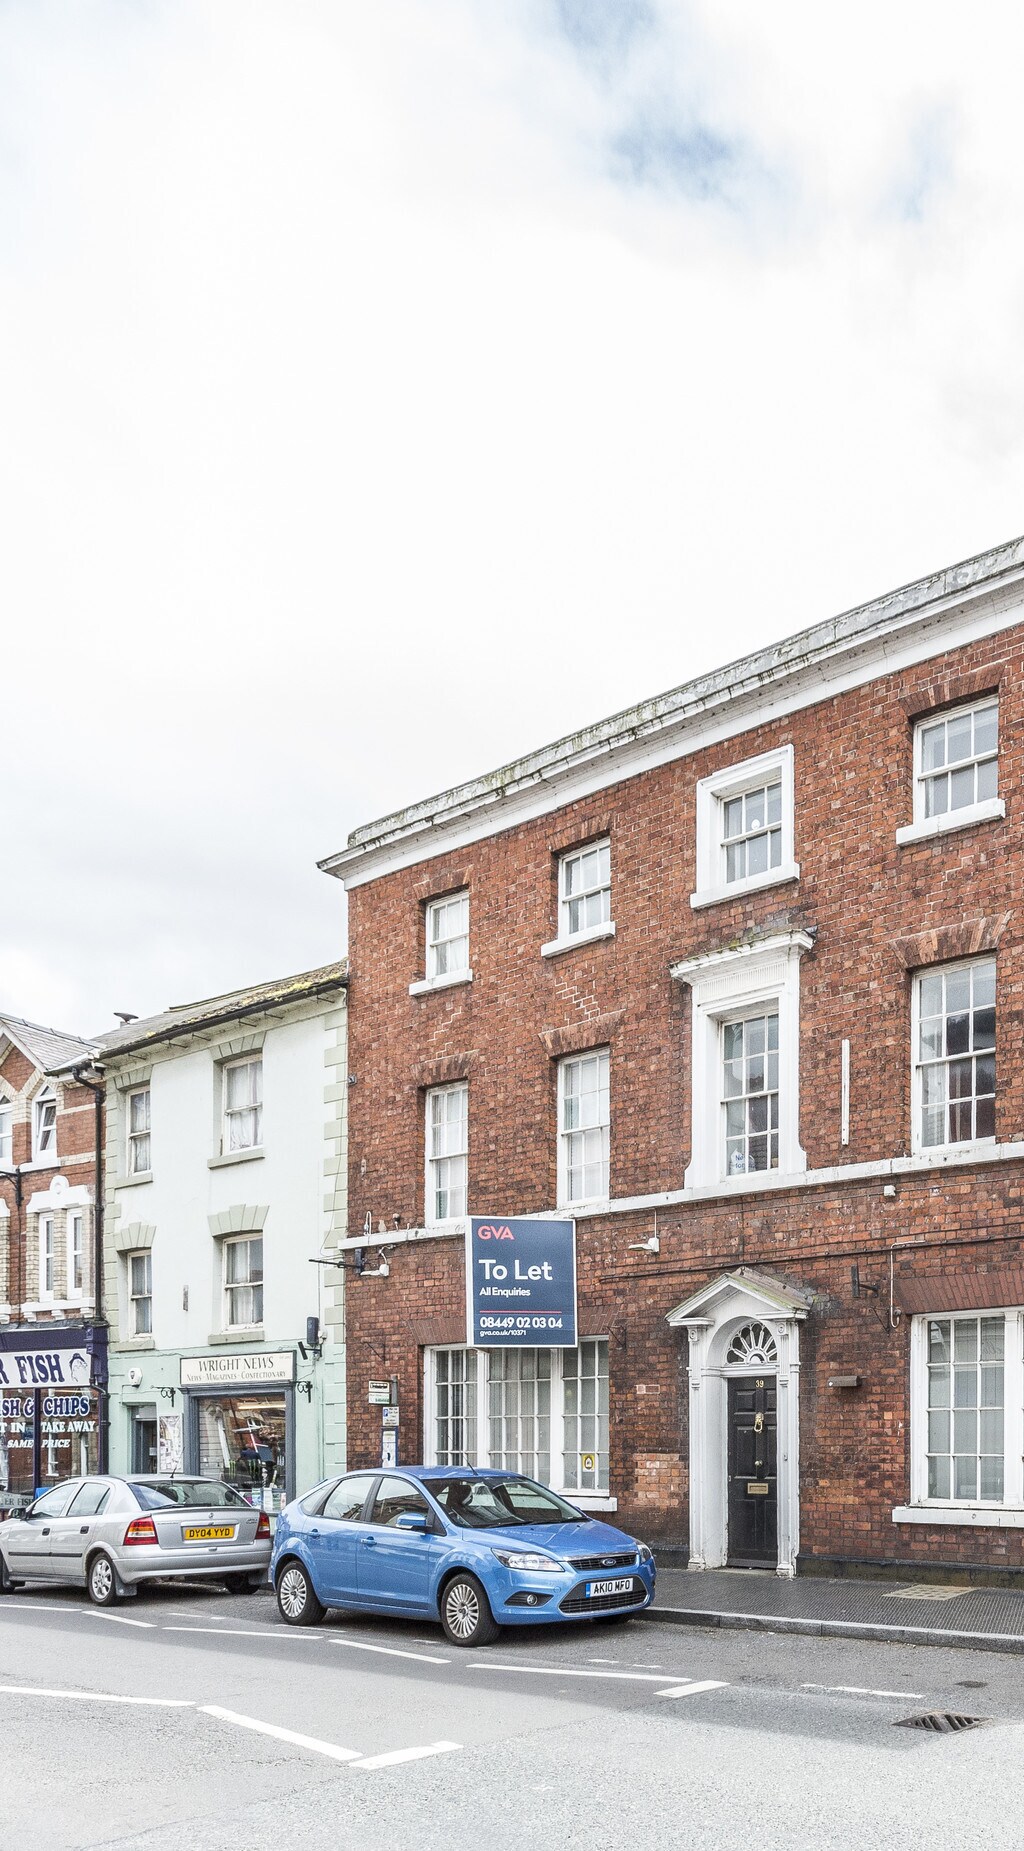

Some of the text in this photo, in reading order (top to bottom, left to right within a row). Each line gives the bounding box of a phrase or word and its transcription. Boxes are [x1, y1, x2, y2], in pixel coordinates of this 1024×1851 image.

[477, 1225, 515, 1240] GVA
[479, 1259, 553, 1280] To Let
[479, 1287, 531, 1298] All Enquiries
[480, 1317, 563, 1329] 08449 02 03 04
[480, 1329, 527, 1338] gva.co.uk/10371
[14, 1353, 65, 1384] FISH
[198, 1356, 274, 1371] WRIGHT NEWS
[755, 1379, 764, 1388] 39
[43, 1395, 91, 1417] CHIPS
[10, 1422, 26, 1433] IN
[41, 1421, 65, 1433] TAKE
[67, 1420, 96, 1432] AWAY
[7, 1438, 71, 1448] SAME PRICE
[189, 1528, 230, 1538] DY04 YYD
[593, 1582, 613, 1594] AK10
